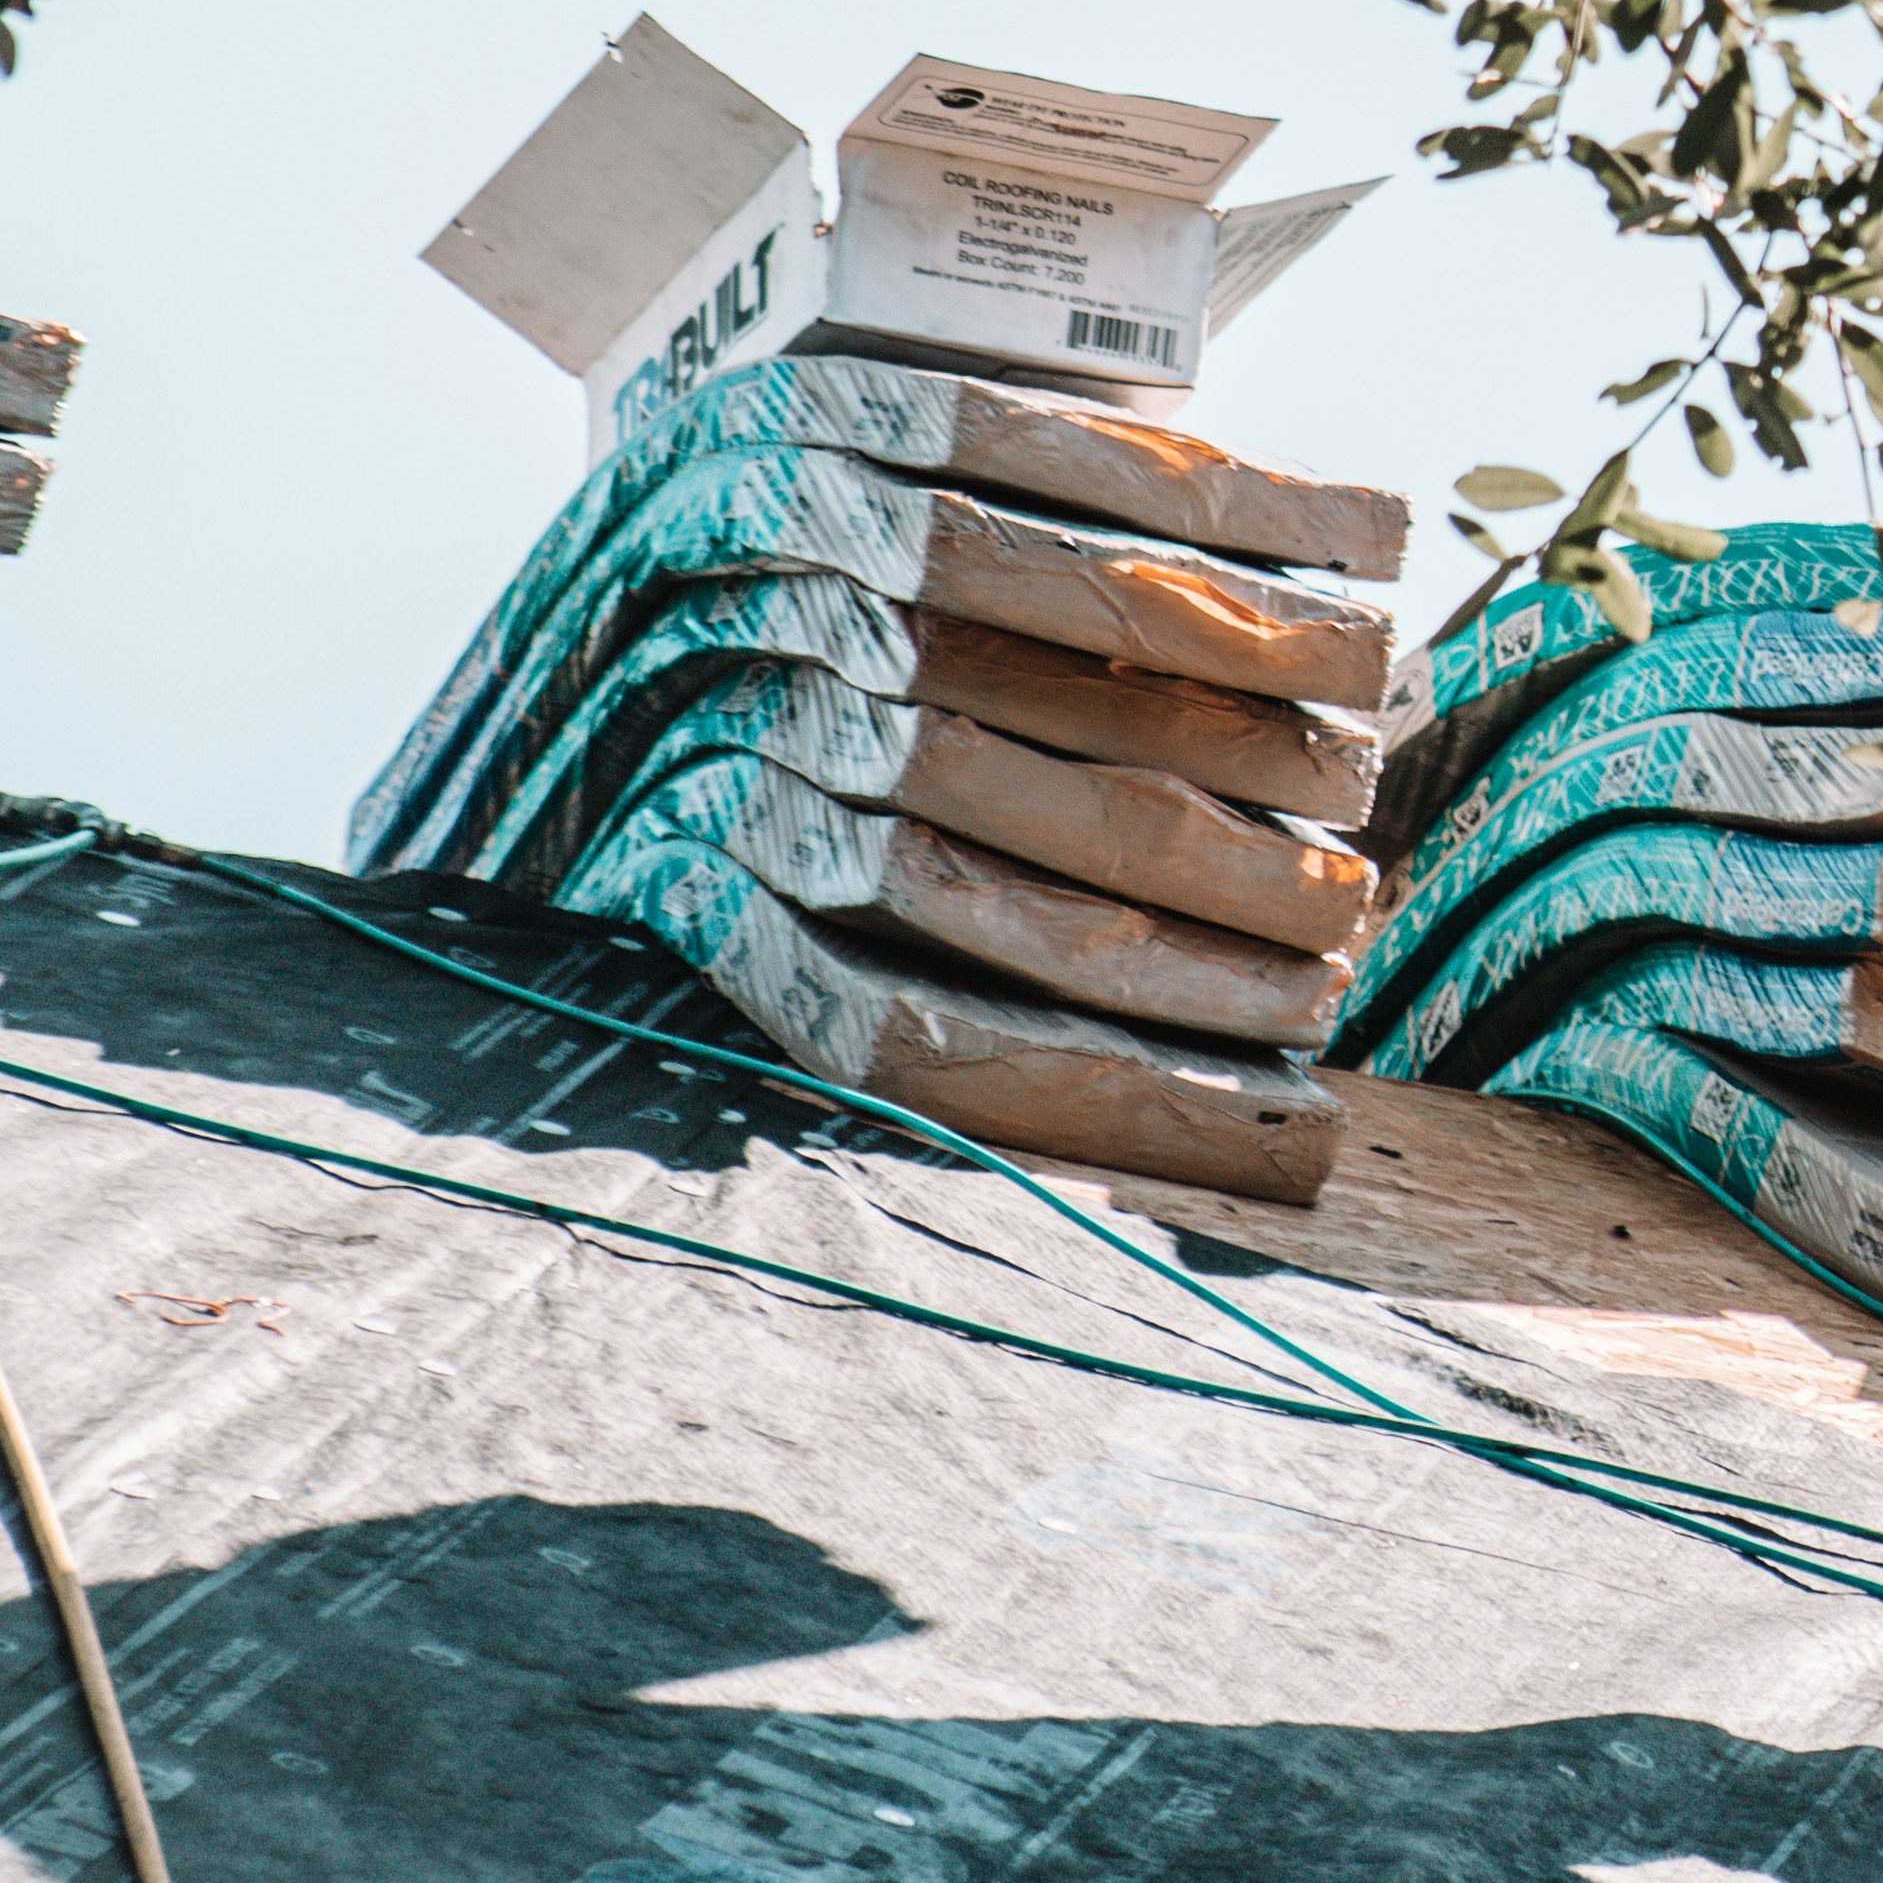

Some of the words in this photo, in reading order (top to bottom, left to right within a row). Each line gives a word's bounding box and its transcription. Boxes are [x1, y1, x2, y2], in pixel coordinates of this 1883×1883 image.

[942, 170, 980, 191] COIL
[985, 175, 1062, 207] ROOFING
[1067, 193, 1114, 216] NAILS
[972, 195, 1082, 228] TRINLSCR114
[959, 230, 1088, 268] Electrogalvanized
[1022, 226, 1031, 237] x
[1035, 227, 1077, 246] 0.120
[957, 250, 986, 267] Box
